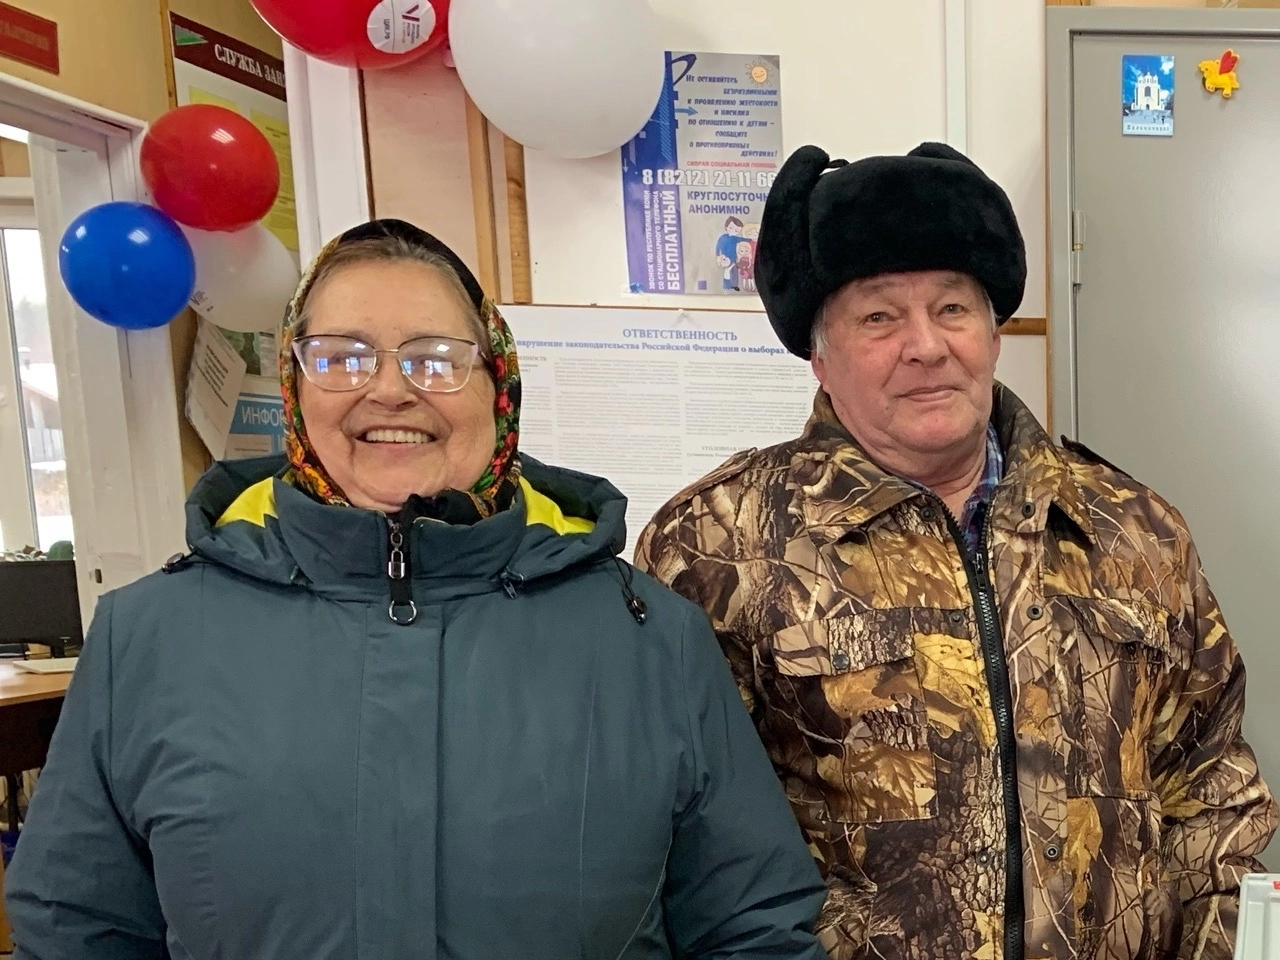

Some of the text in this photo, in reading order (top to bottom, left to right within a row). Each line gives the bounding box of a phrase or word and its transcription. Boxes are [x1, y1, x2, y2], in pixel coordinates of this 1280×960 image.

[214, 43, 263, 78] СЛУЖБА
[642, 169, 653, 185] 8
[688, 204, 750, 215] АНОНИМНО
[643, 190, 656, 290] ЗВОНОК ПО РЕСПУБЛИКЕ КОМИ
[653, 190, 665, 290] СО СТАЦИОНАРНОГО ТЕЛЕФОНА
[660, 190, 680, 290] БЕСПЛАТНЫЙ
[516, 339, 563, 349] нарушение
[565, 340, 639, 350] законодательства
[641, 342, 690, 351] Российской
[692, 343, 739, 353] Федерации
[748, 346, 785, 356] выборах
[622, 328, 738, 342] ОТВЕТСТВЕННОСТЬ
